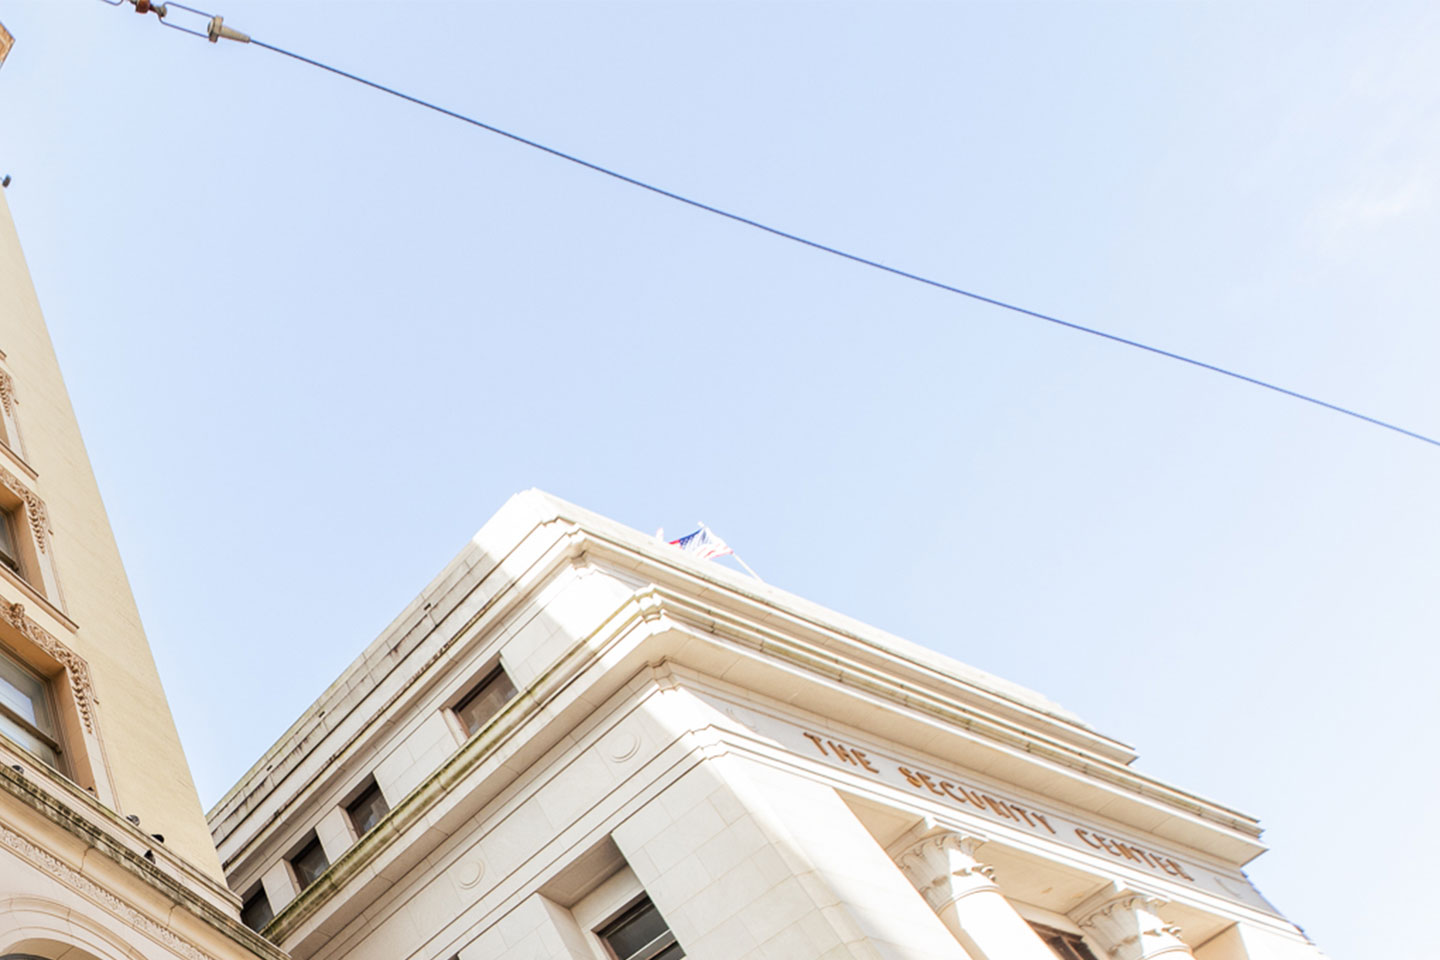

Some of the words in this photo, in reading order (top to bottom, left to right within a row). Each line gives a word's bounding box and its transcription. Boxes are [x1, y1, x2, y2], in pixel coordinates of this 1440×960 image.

[803, 731, 880, 775] THE
[897, 765, 1058, 836] SECURITY
[1074, 827, 1196, 884] CENTER
